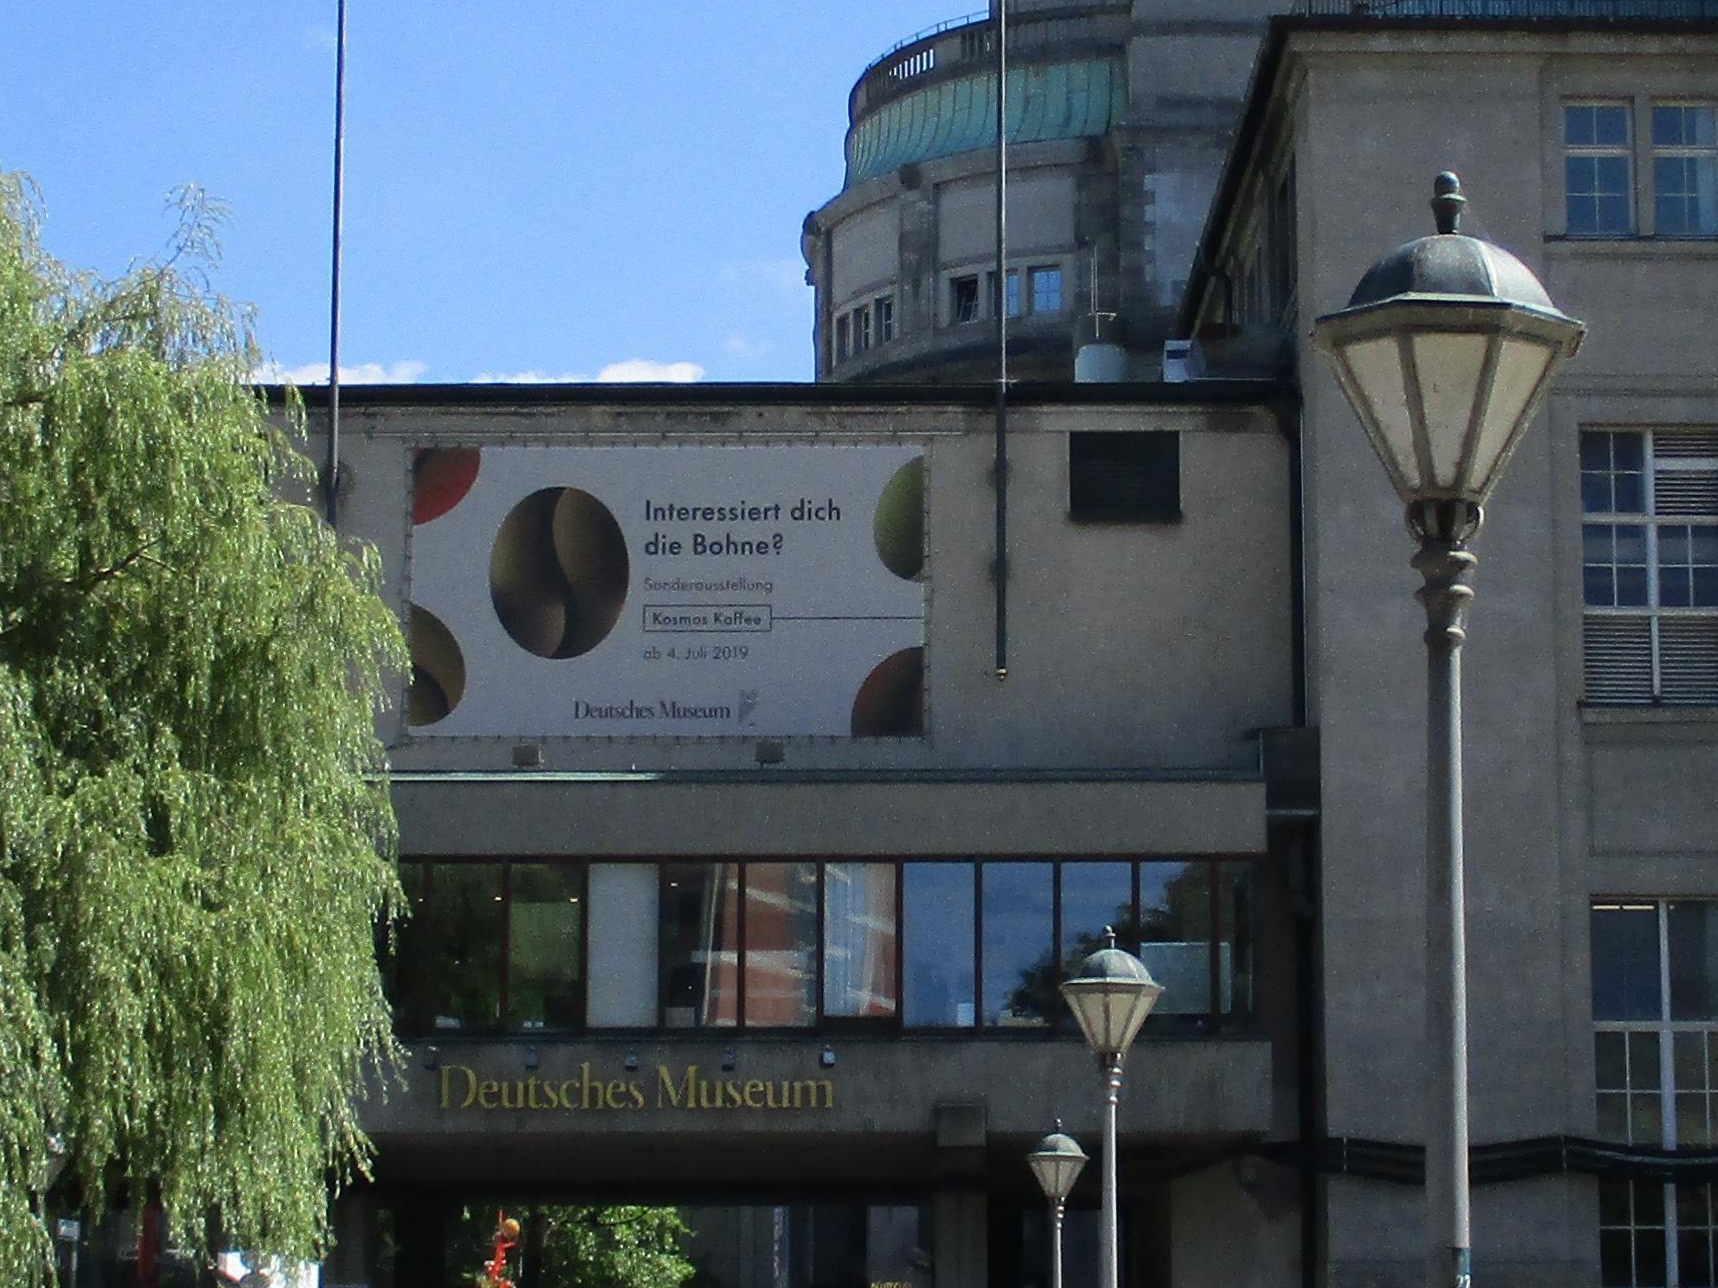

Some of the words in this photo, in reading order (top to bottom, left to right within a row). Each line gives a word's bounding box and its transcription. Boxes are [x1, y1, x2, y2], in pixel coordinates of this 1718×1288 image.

[644, 499, 781, 522] Interessiert
[790, 498, 842, 522] dich
[644, 532, 683, 556] die
[693, 532, 784, 556] Bohne?
[643, 577, 774, 594] Sonderausstellung
[652, 612, 708, 626] Kosmos
[713, 611, 762, 626] Kaffee
[643, 646, 661, 660] ab
[666, 647, 680, 660] 4.
[685, 645, 708, 660] Juli
[713, 646, 749, 660] 2019
[574, 699, 655, 719] Deutsches
[659, 700, 731, 719] Museum
[439, 1062, 645, 1109] Deutsches
[656, 1064, 834, 1109] Museum
